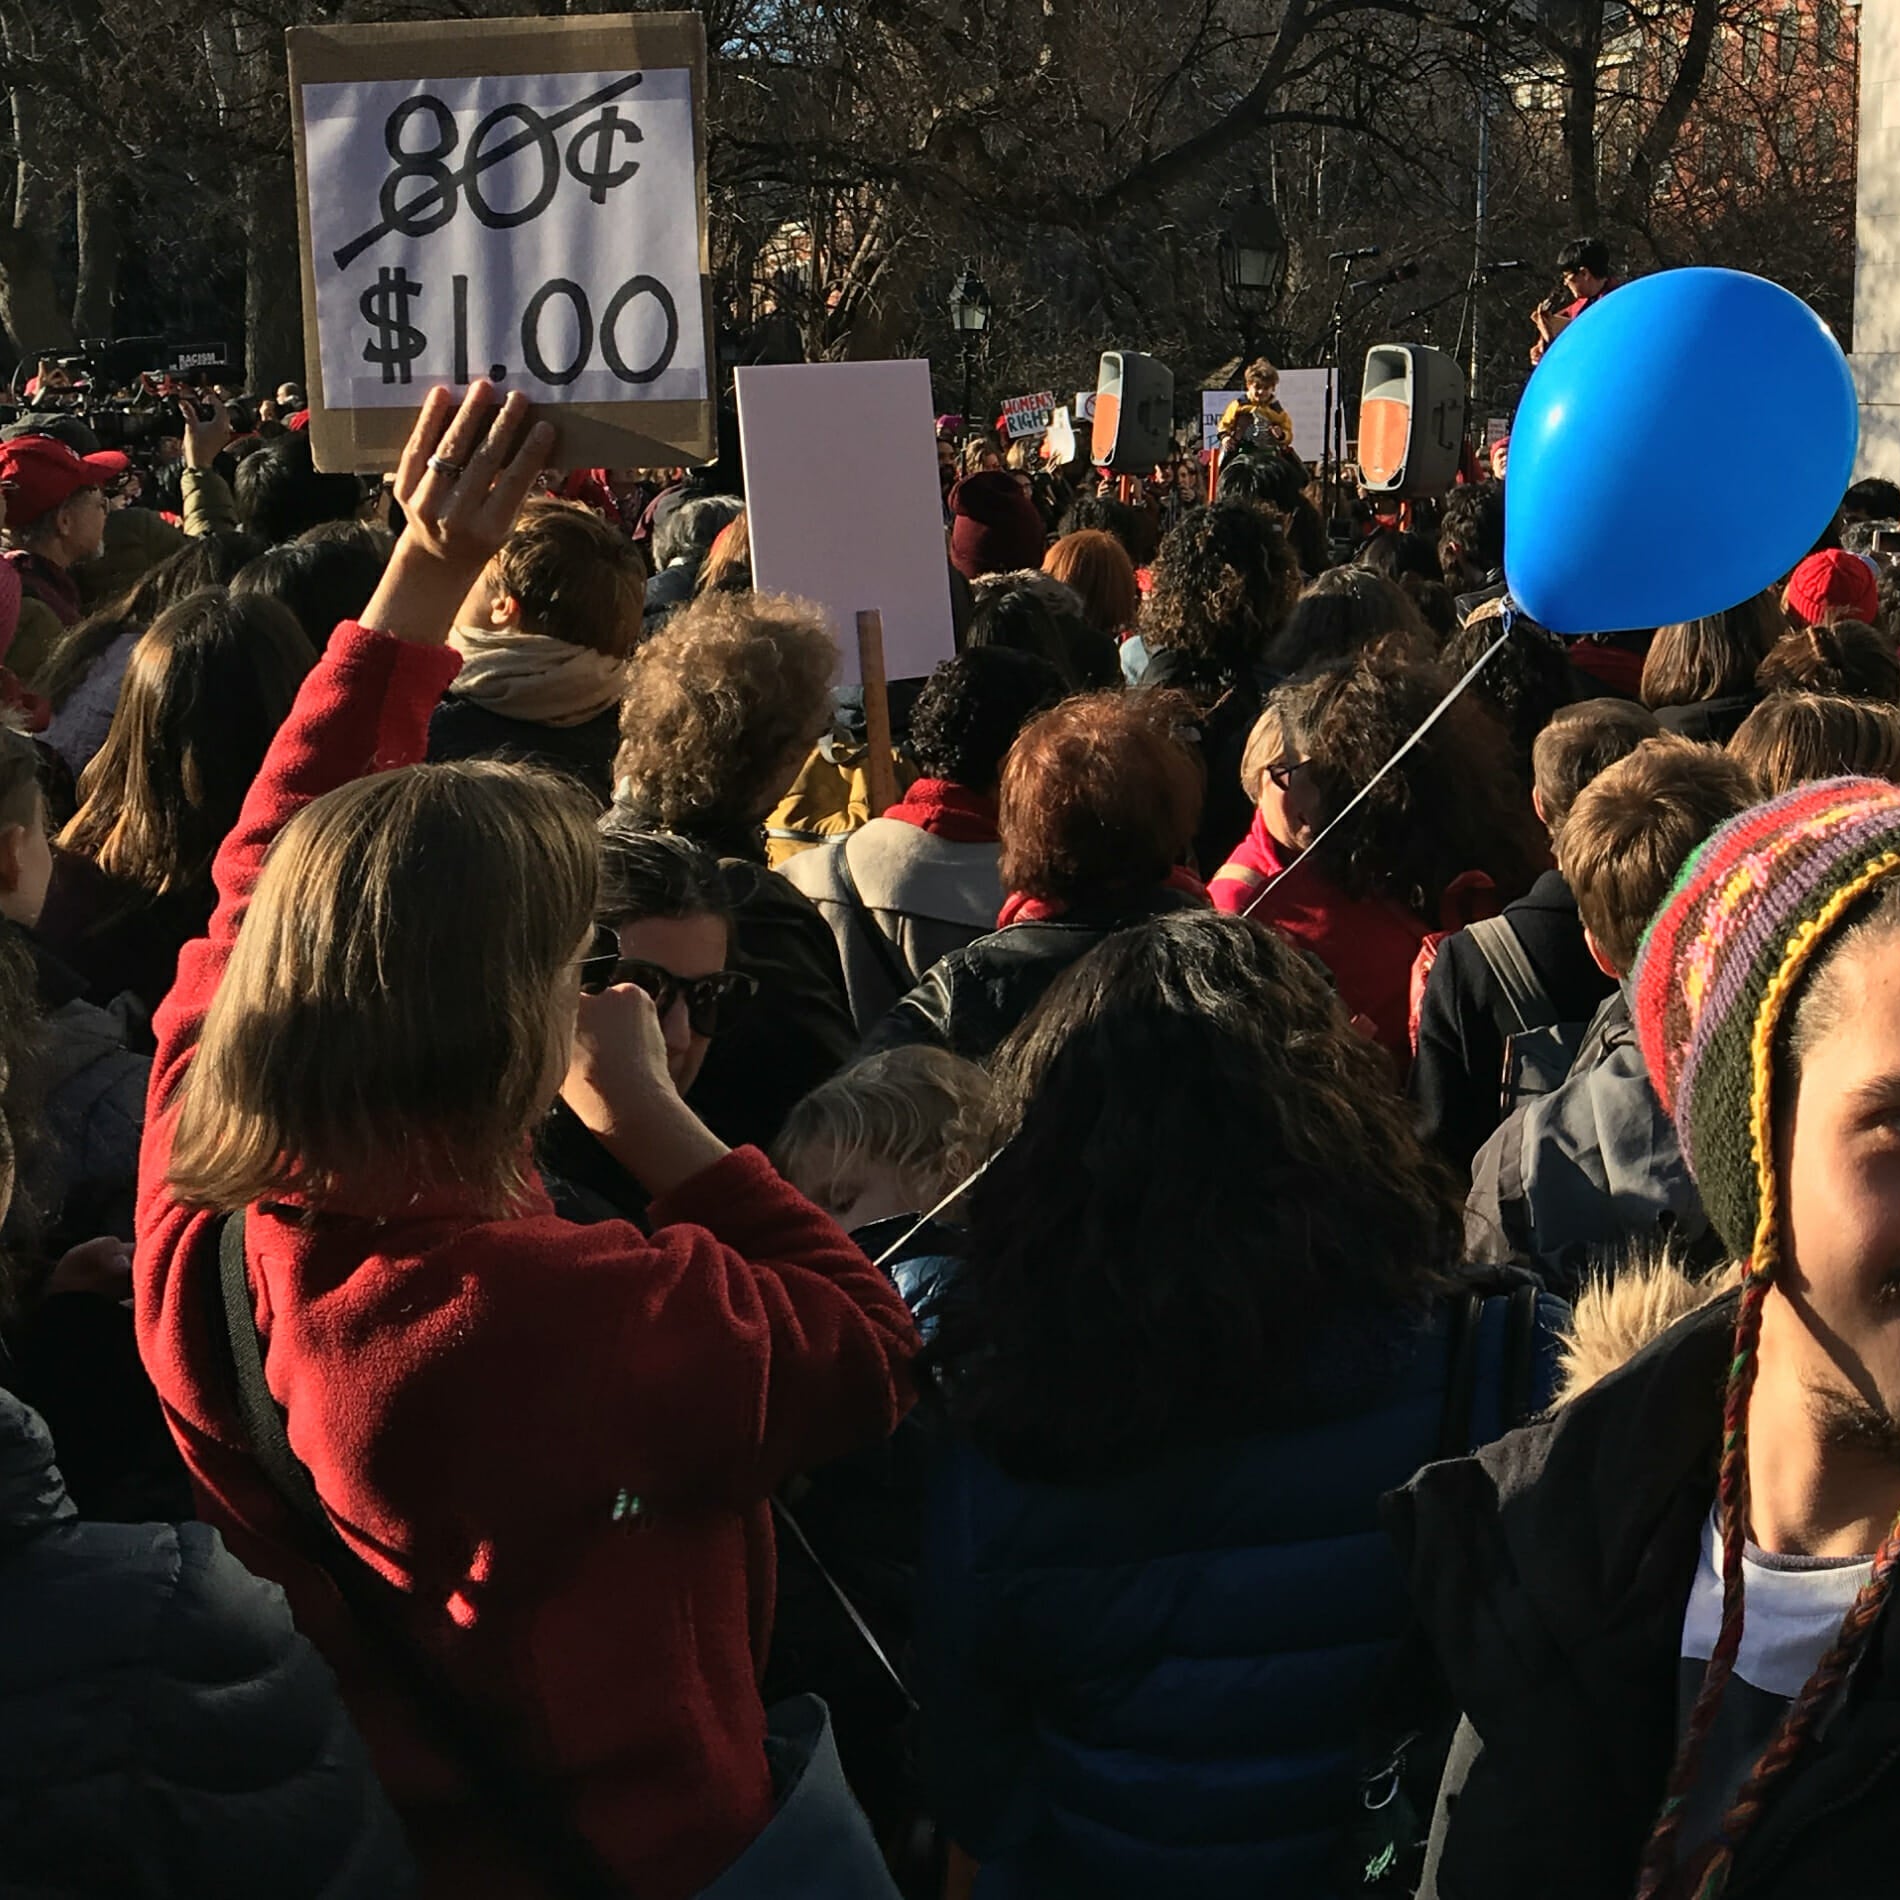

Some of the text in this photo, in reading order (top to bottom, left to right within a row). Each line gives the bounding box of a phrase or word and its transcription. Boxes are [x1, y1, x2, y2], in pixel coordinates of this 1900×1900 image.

[379, 94, 644, 238] 80¢
[178, 352, 215, 368] RACISM
[358, 266, 679, 385] $1.00
